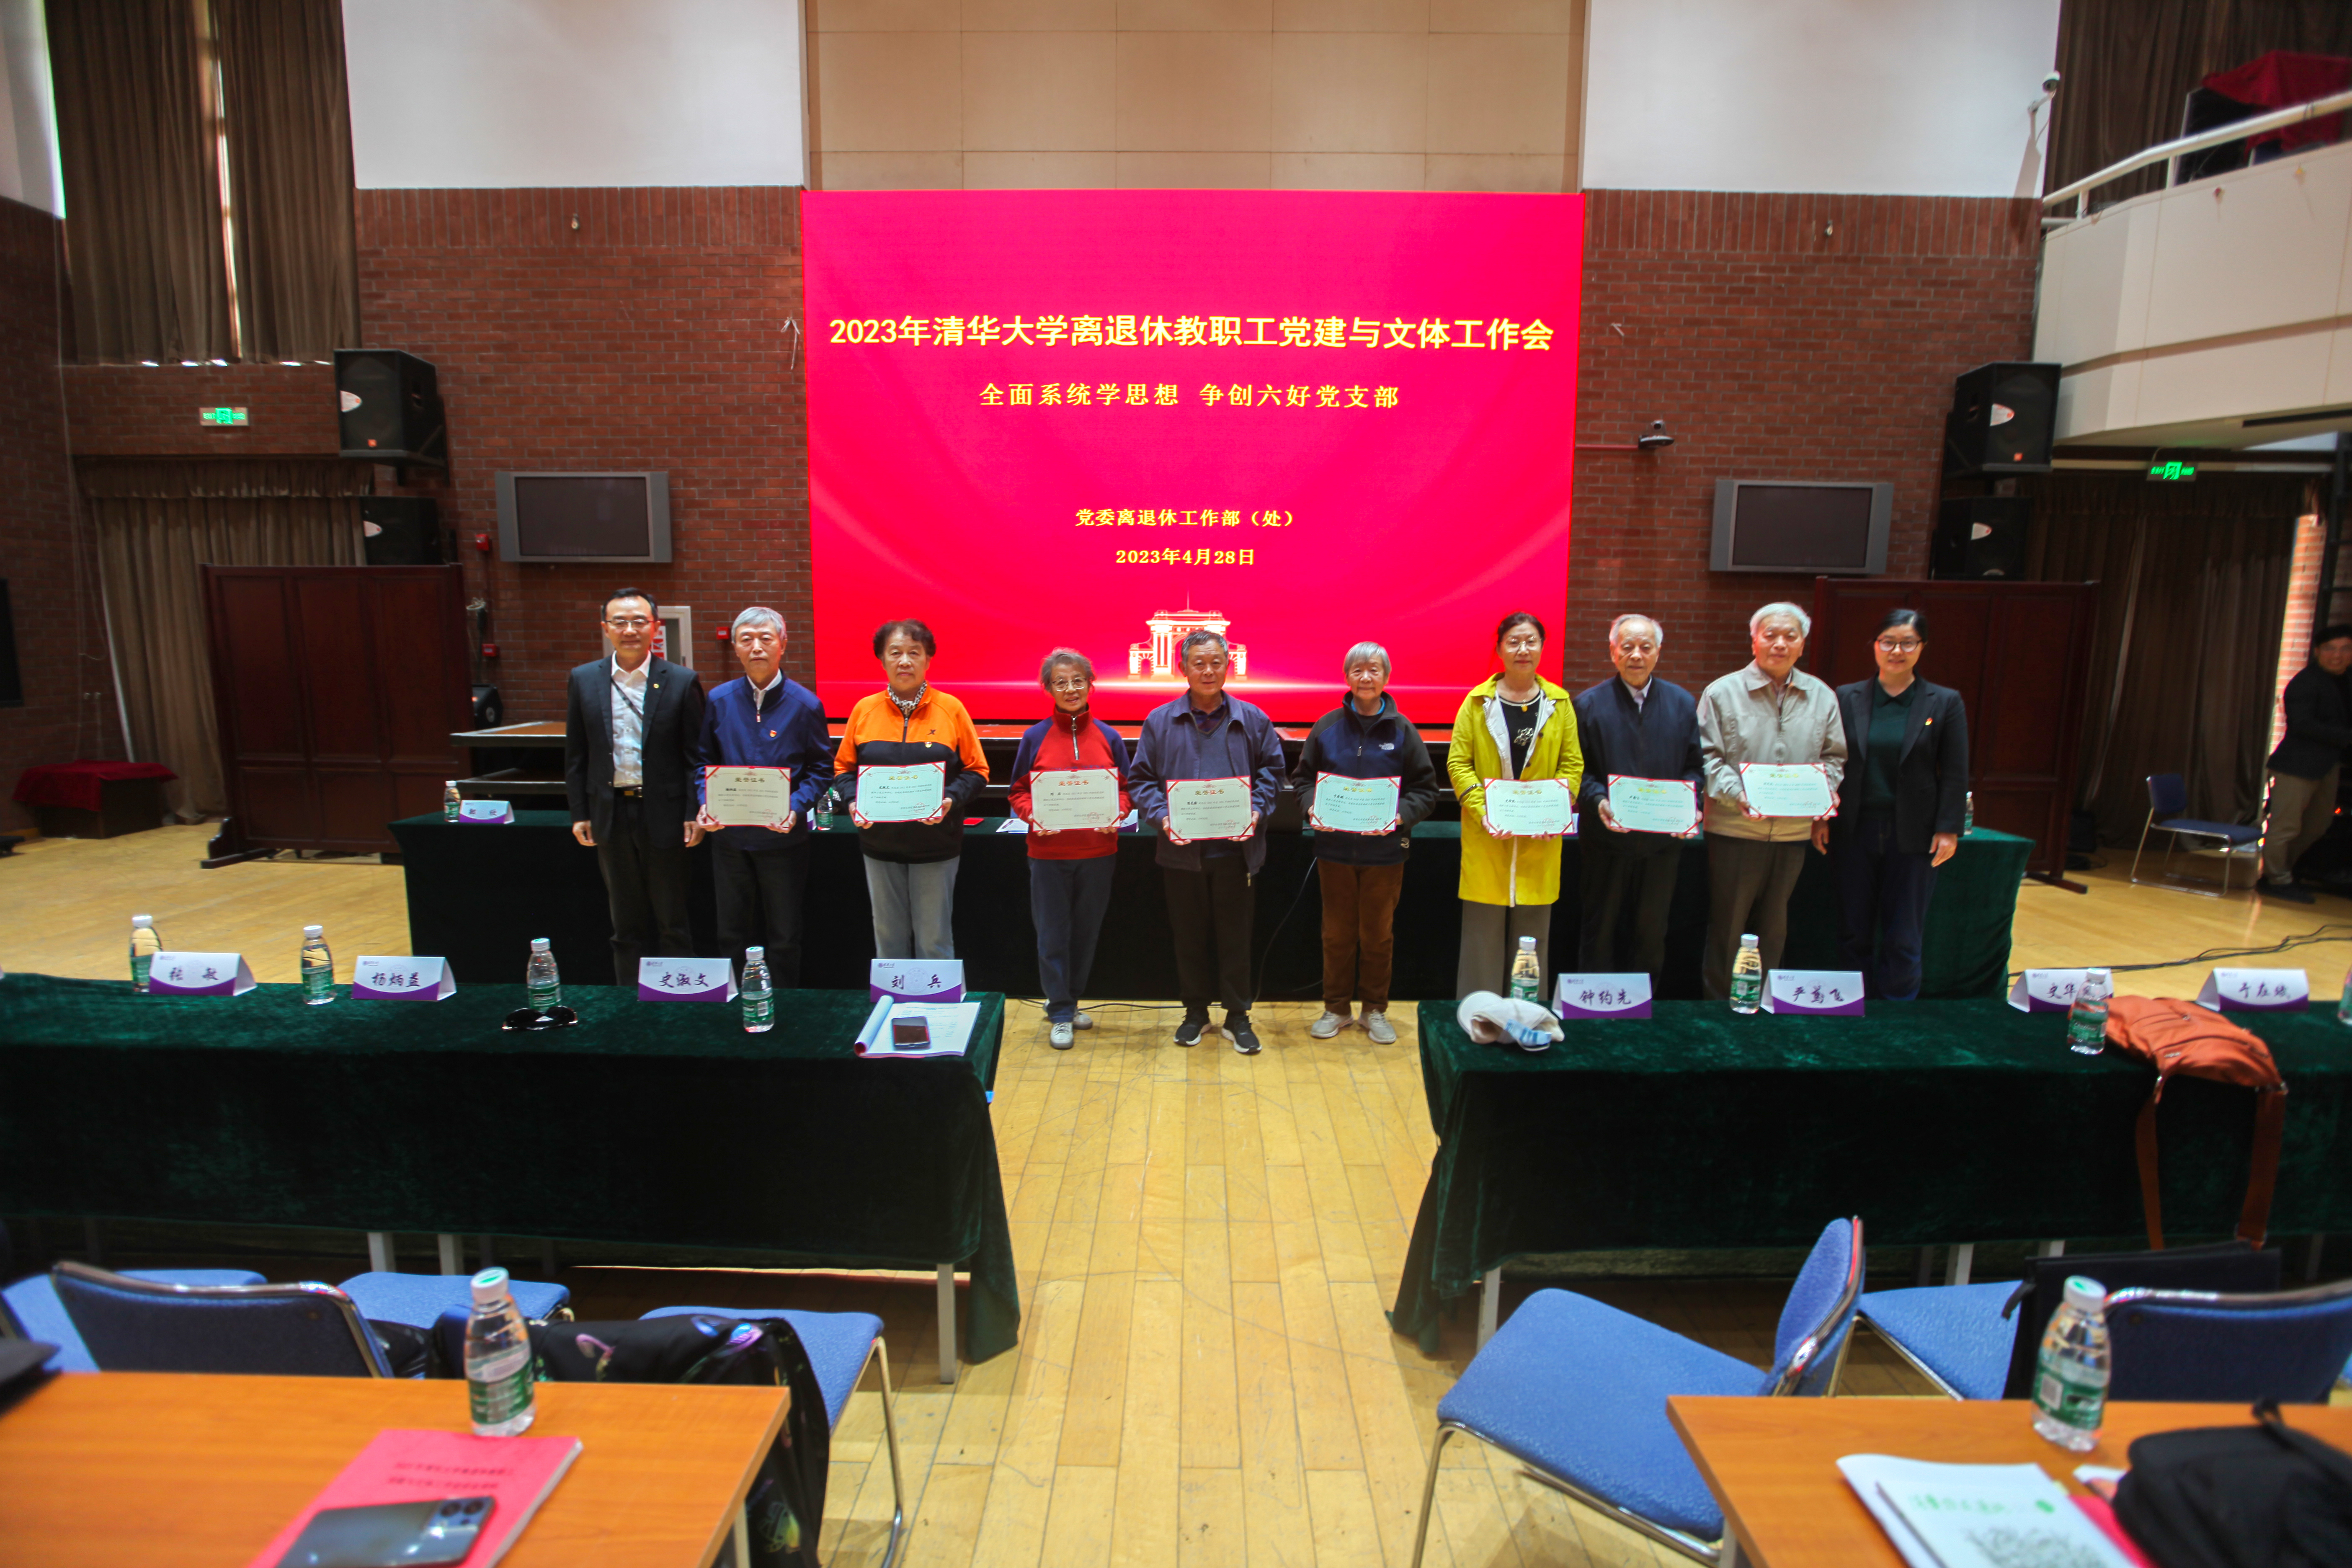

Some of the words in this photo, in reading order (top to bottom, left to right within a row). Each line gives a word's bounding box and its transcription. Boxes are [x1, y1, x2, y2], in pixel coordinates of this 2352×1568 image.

[830, 314, 1554, 351] 2023年清华大学离退休教职工党建与文体工作会
[979, 382, 1179, 407] 全面系统学思想
[1199, 383, 1400, 410] 争创六好党支部
[1075, 508, 1294, 528] 党委离退休工作部（处）
[1115, 547, 1255, 566] 2023年4月28日
[658, 971, 709, 988] 史淑文
[890, 974, 942, 990] 刘兵
[1578, 988, 1632, 1006] 钟约先
